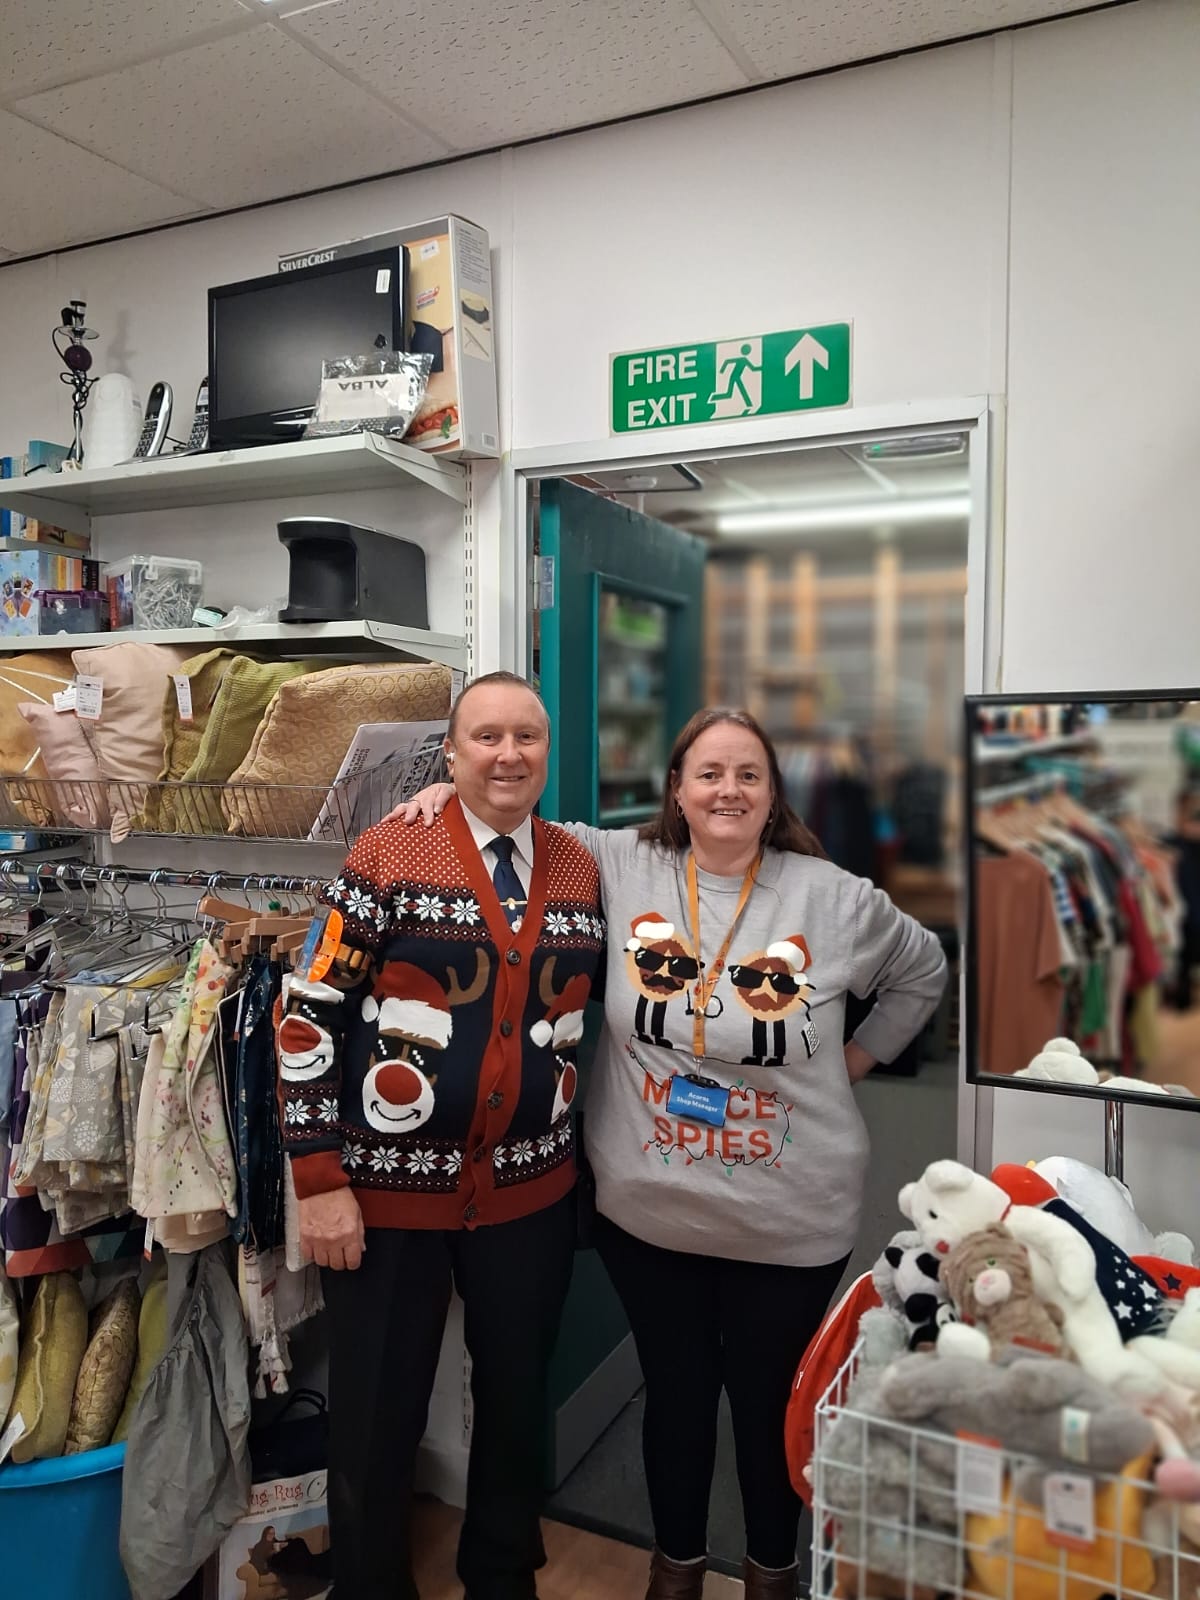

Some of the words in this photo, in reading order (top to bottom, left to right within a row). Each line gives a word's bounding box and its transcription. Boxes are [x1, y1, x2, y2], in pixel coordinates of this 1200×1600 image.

[338, 379, 389, 391] ALBA
[628, 350, 698, 386] FIRE
[628, 393, 697, 428] EXIT
[643, 1071, 777, 1120] MCE
[677, 1096, 691, 1106] Shop
[692, 1100, 718, 1112] Manager
[654, 1116, 773, 1160] SPIES
[249, 1482, 304, 1506] ug-Rug
